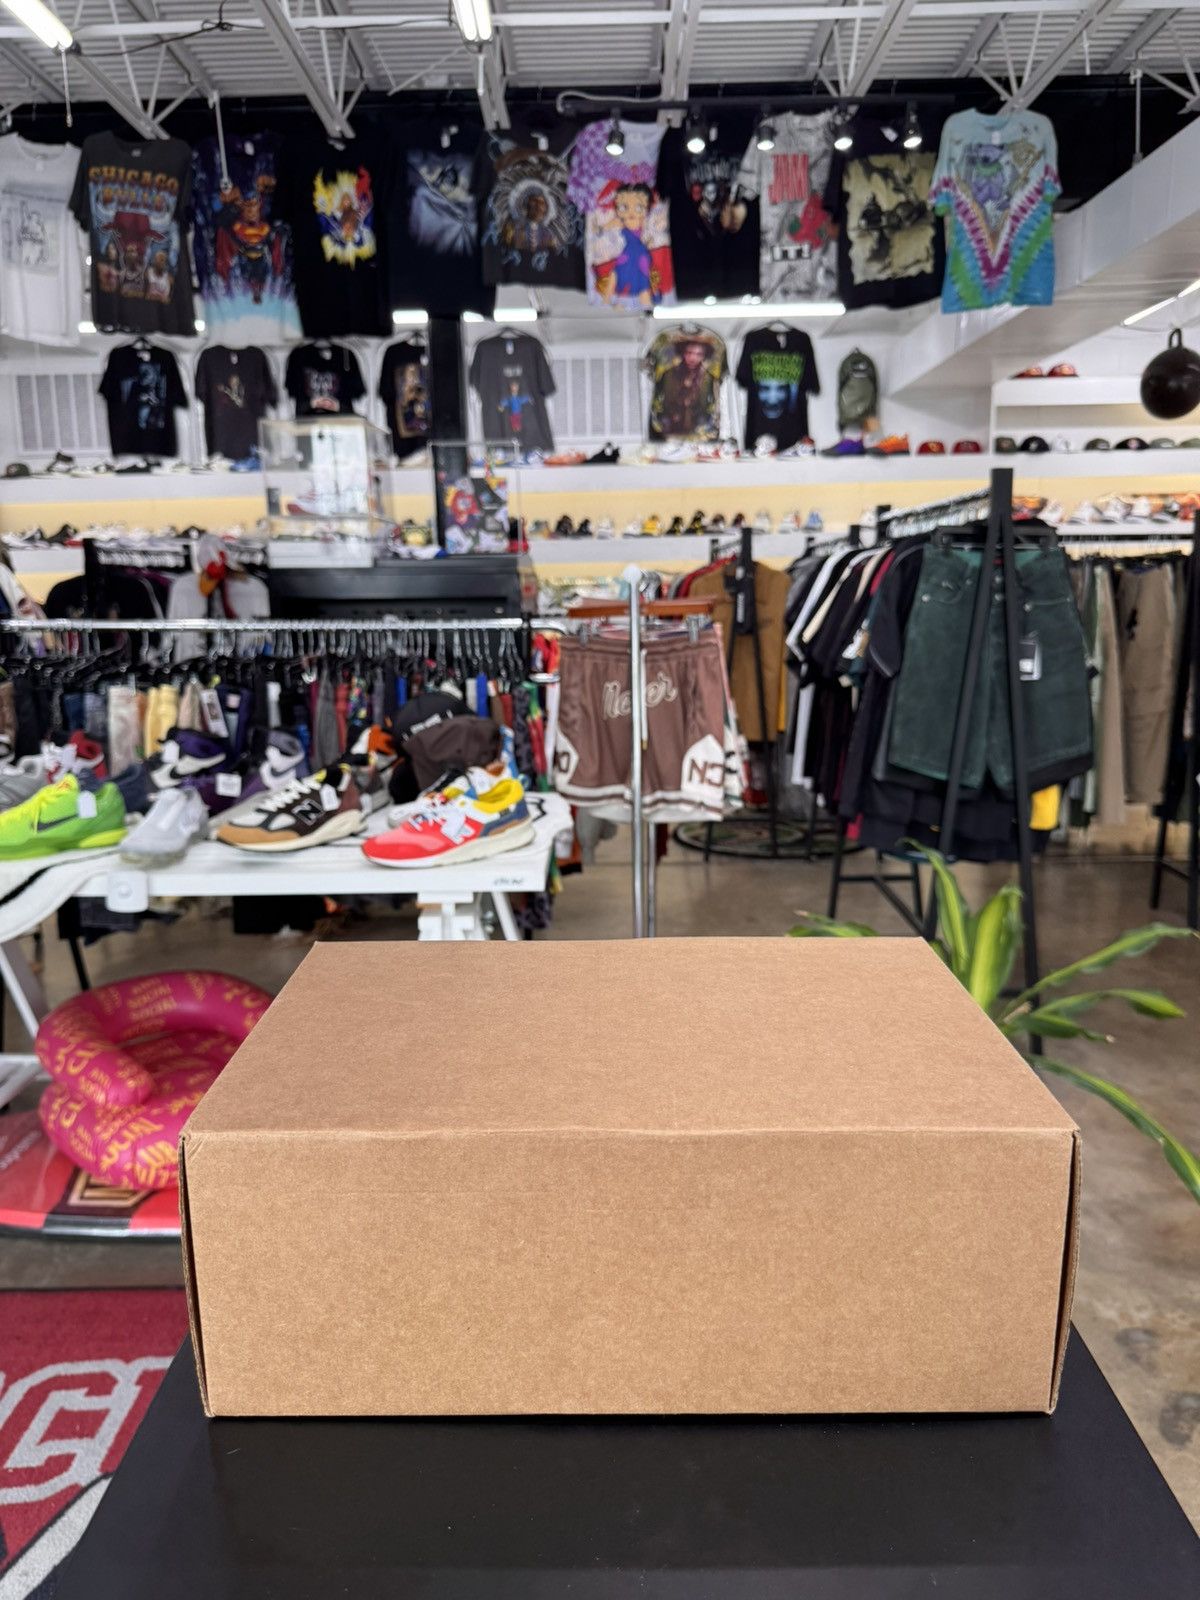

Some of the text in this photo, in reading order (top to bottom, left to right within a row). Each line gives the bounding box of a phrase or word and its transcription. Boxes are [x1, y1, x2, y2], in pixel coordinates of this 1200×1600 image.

[88, 165, 179, 195] CHICAGO
[768, 153, 809, 205] JAM
[602, 671, 678, 720] Neer
